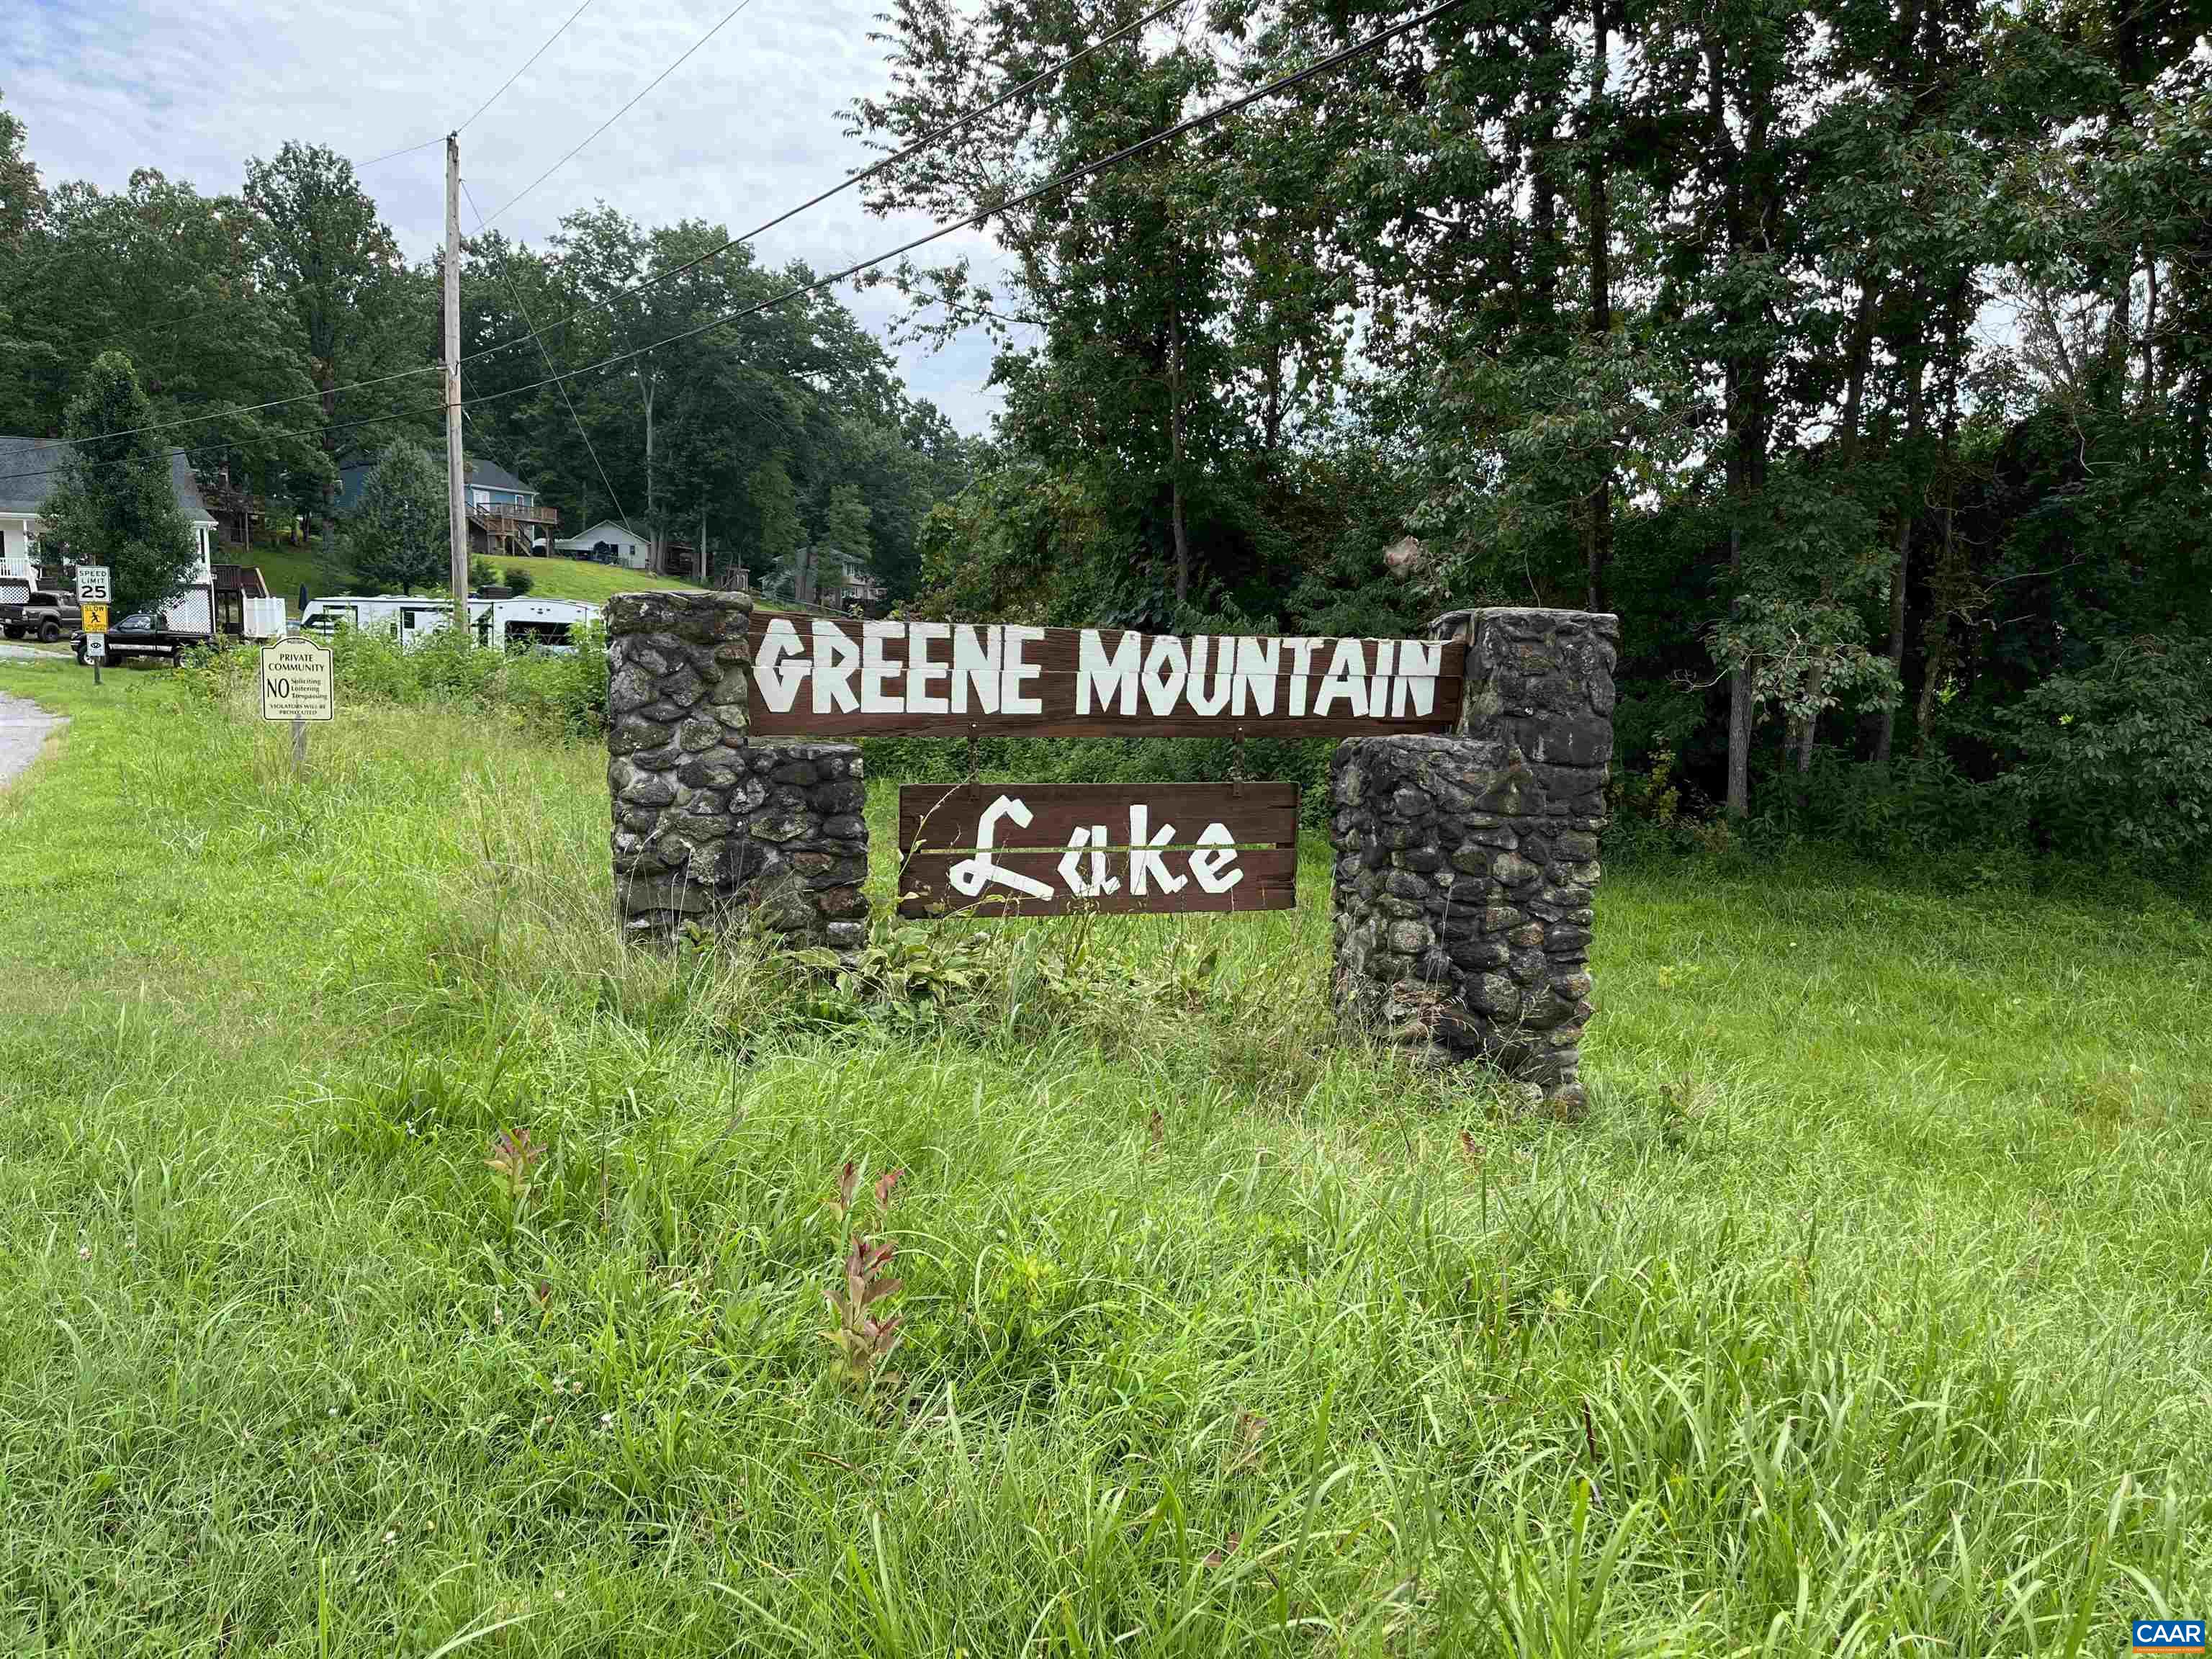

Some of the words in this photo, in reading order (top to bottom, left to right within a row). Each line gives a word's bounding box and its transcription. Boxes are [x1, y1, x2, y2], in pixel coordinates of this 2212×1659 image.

[81, 585, 107, 598] 25
[279, 653, 313, 662] PRIVATE
[269, 663, 324, 672] COMMUNITY
[753, 618, 1045, 714] GREENE
[1076, 629, 1441, 717] MOUNTAIN
[267, 678, 289, 698] NO
[949, 795, 1244, 901] Lake
